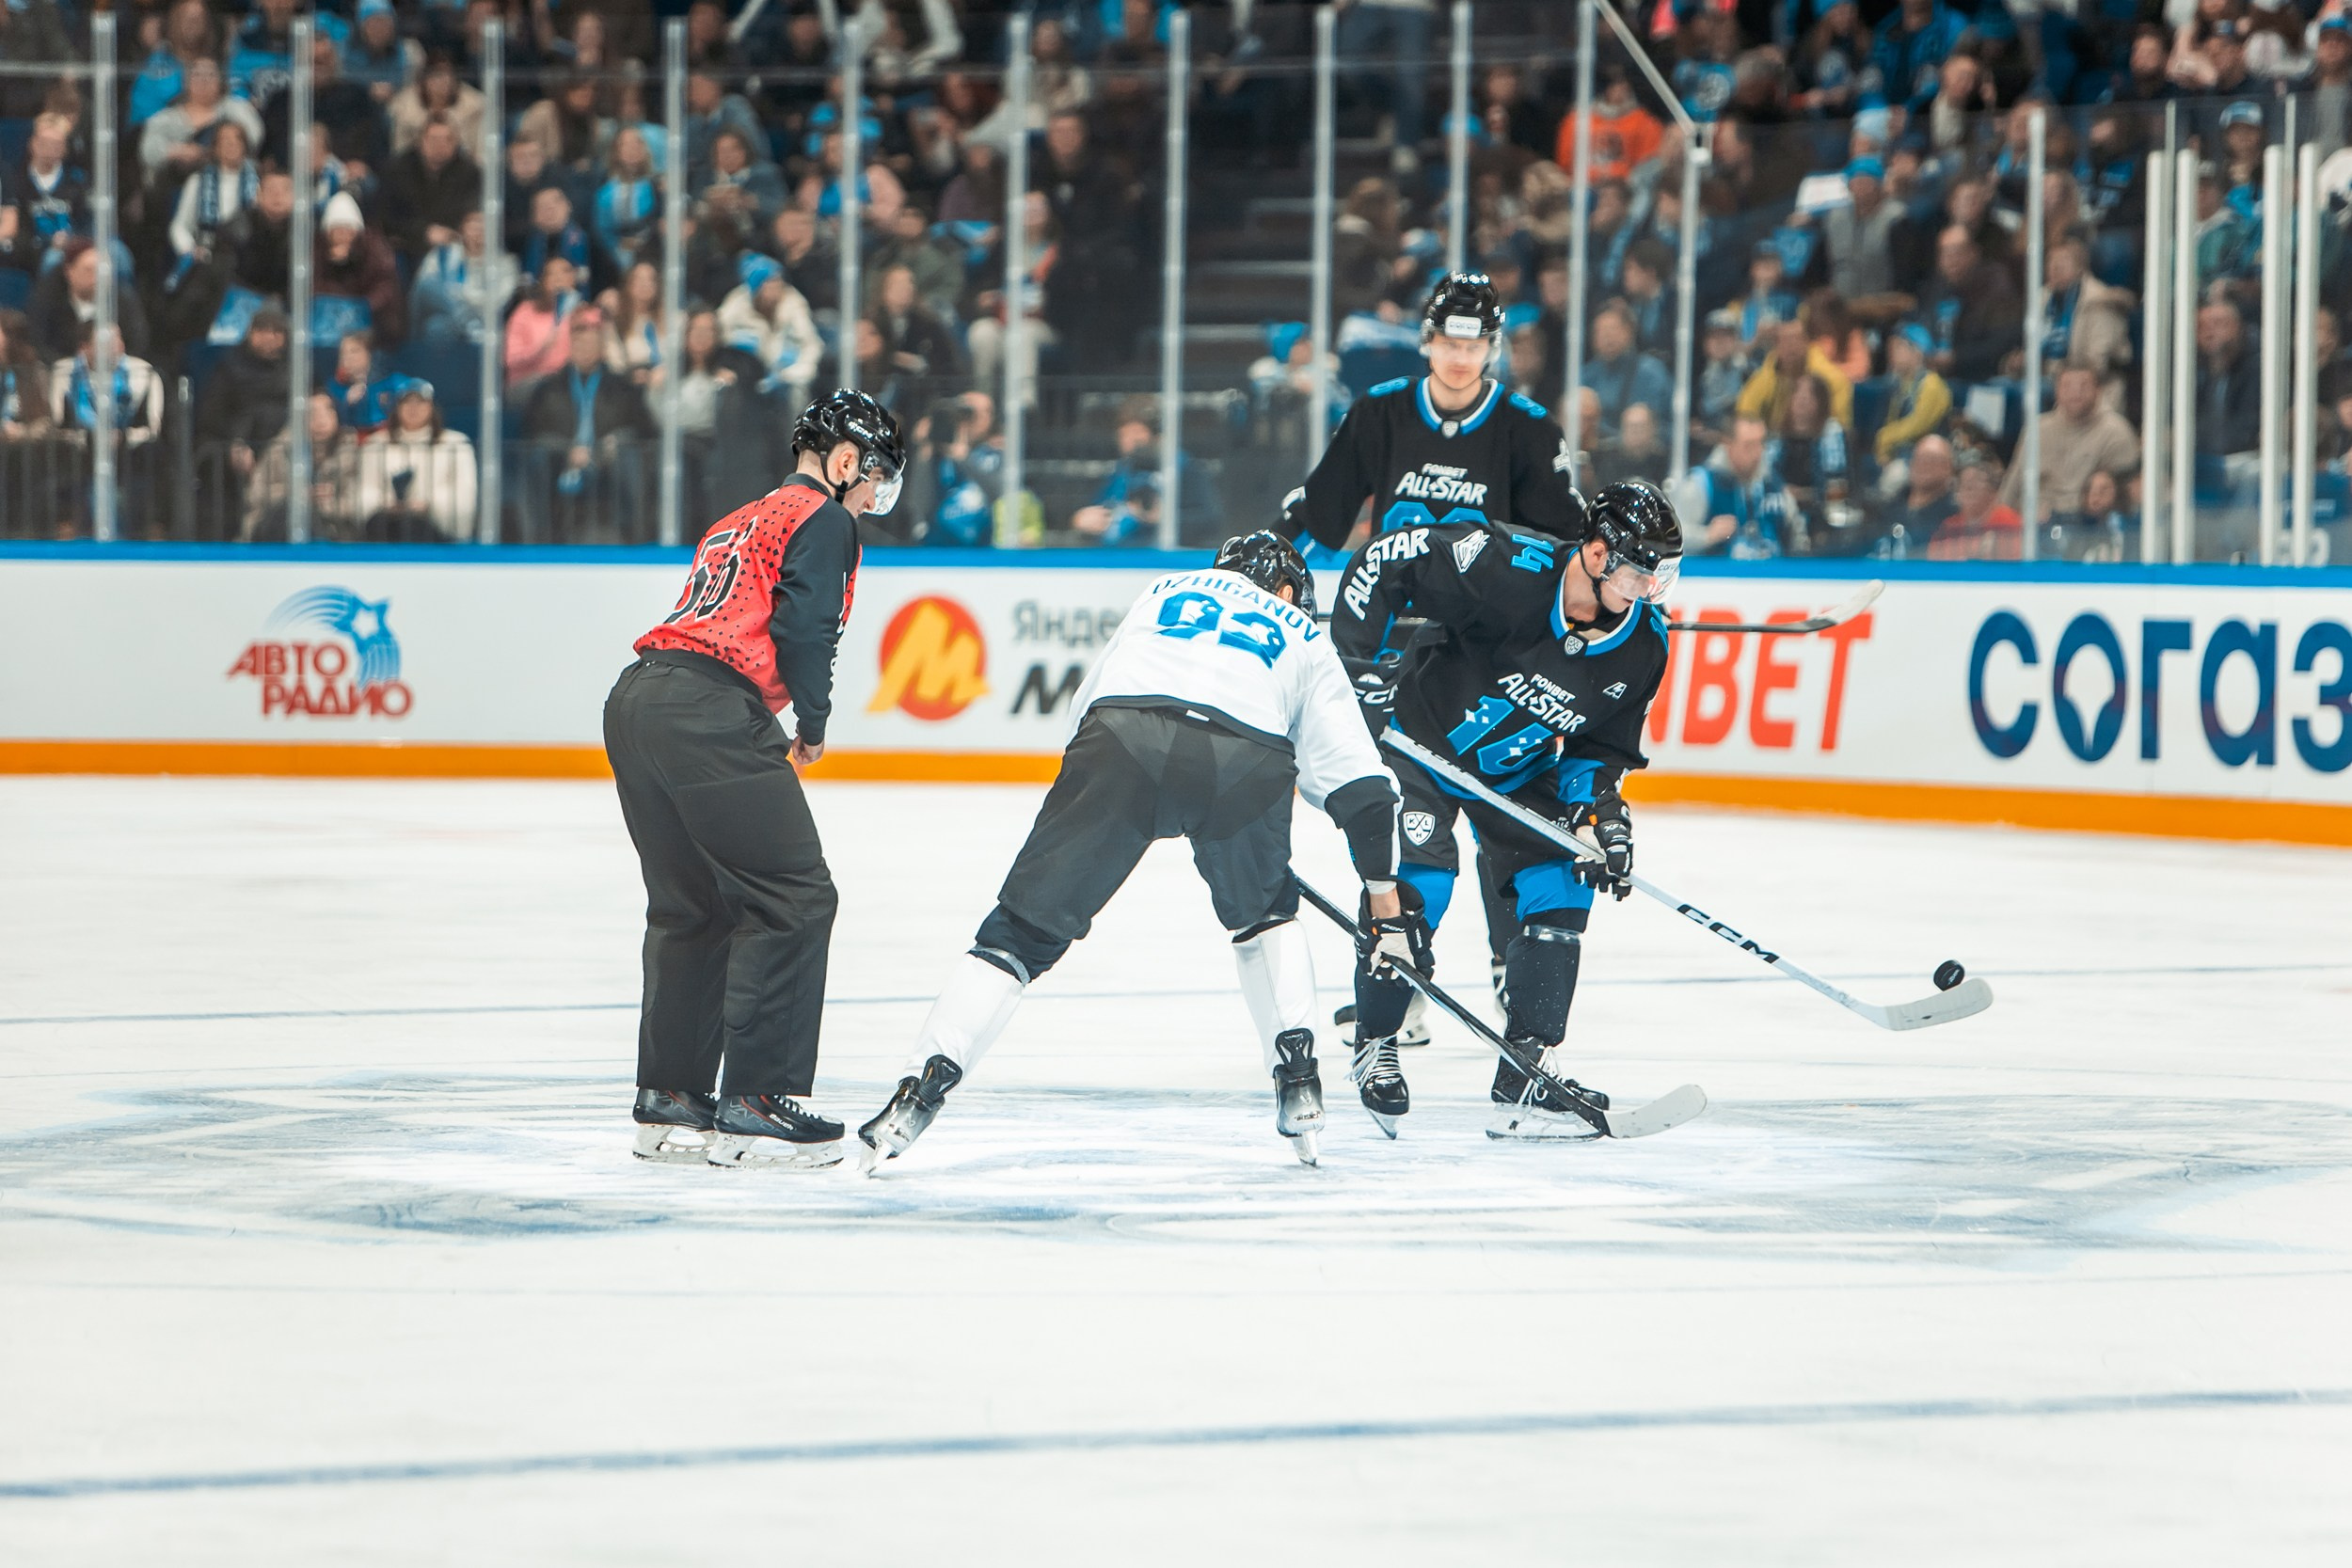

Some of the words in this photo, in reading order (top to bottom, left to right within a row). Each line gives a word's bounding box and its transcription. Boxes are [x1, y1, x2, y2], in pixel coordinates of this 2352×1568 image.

[1422, 464, 1468, 479] FONBET
[1511, 533, 1554, 573] 14
[1013, 599, 1126, 647] Янде
[226, 641, 349, 678] АВТО
[262, 680, 412, 718] РАДИО
[1530, 673, 1576, 704] FONBET
[1677, 903, 1780, 964] CCM
